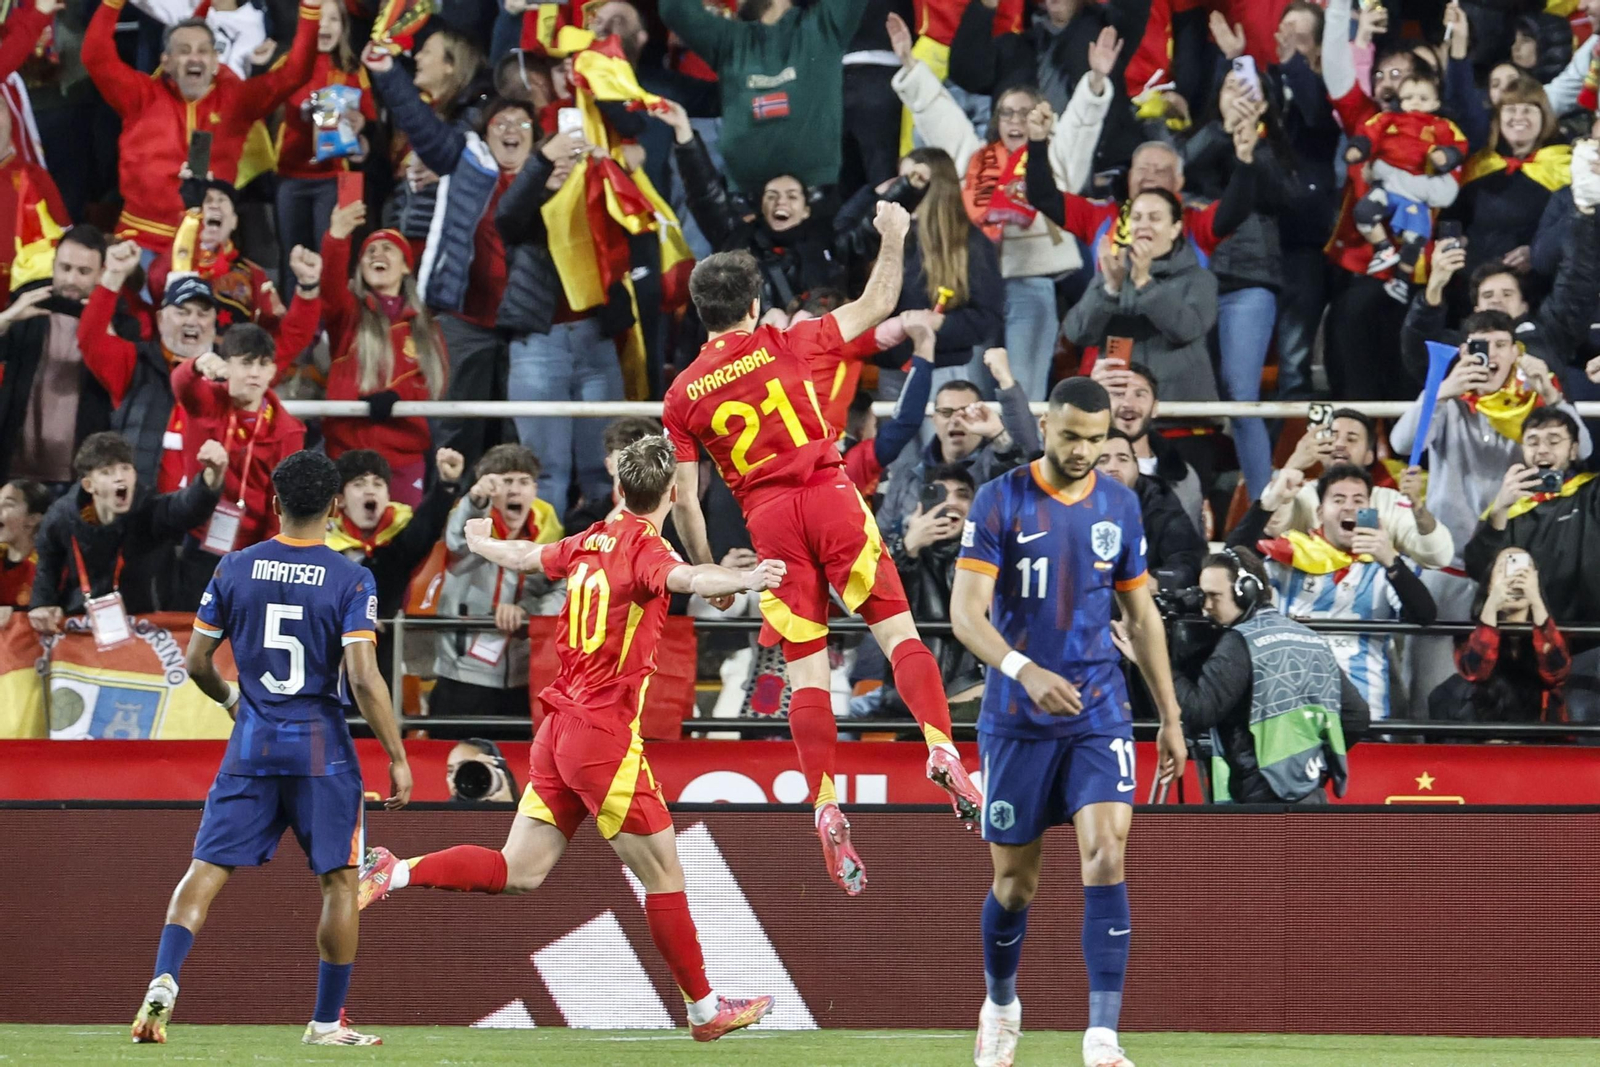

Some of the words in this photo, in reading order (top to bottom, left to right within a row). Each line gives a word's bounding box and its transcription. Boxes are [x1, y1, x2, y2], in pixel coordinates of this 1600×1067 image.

[686, 346, 776, 401] OYARZABAL
[711, 377, 809, 476] 21
[251, 559, 326, 587] MAATSEN
[1015, 557, 1049, 599] 11
[567, 562, 610, 655] 10
[259, 603, 305, 696] 5
[1109, 737, 1136, 781] 11
